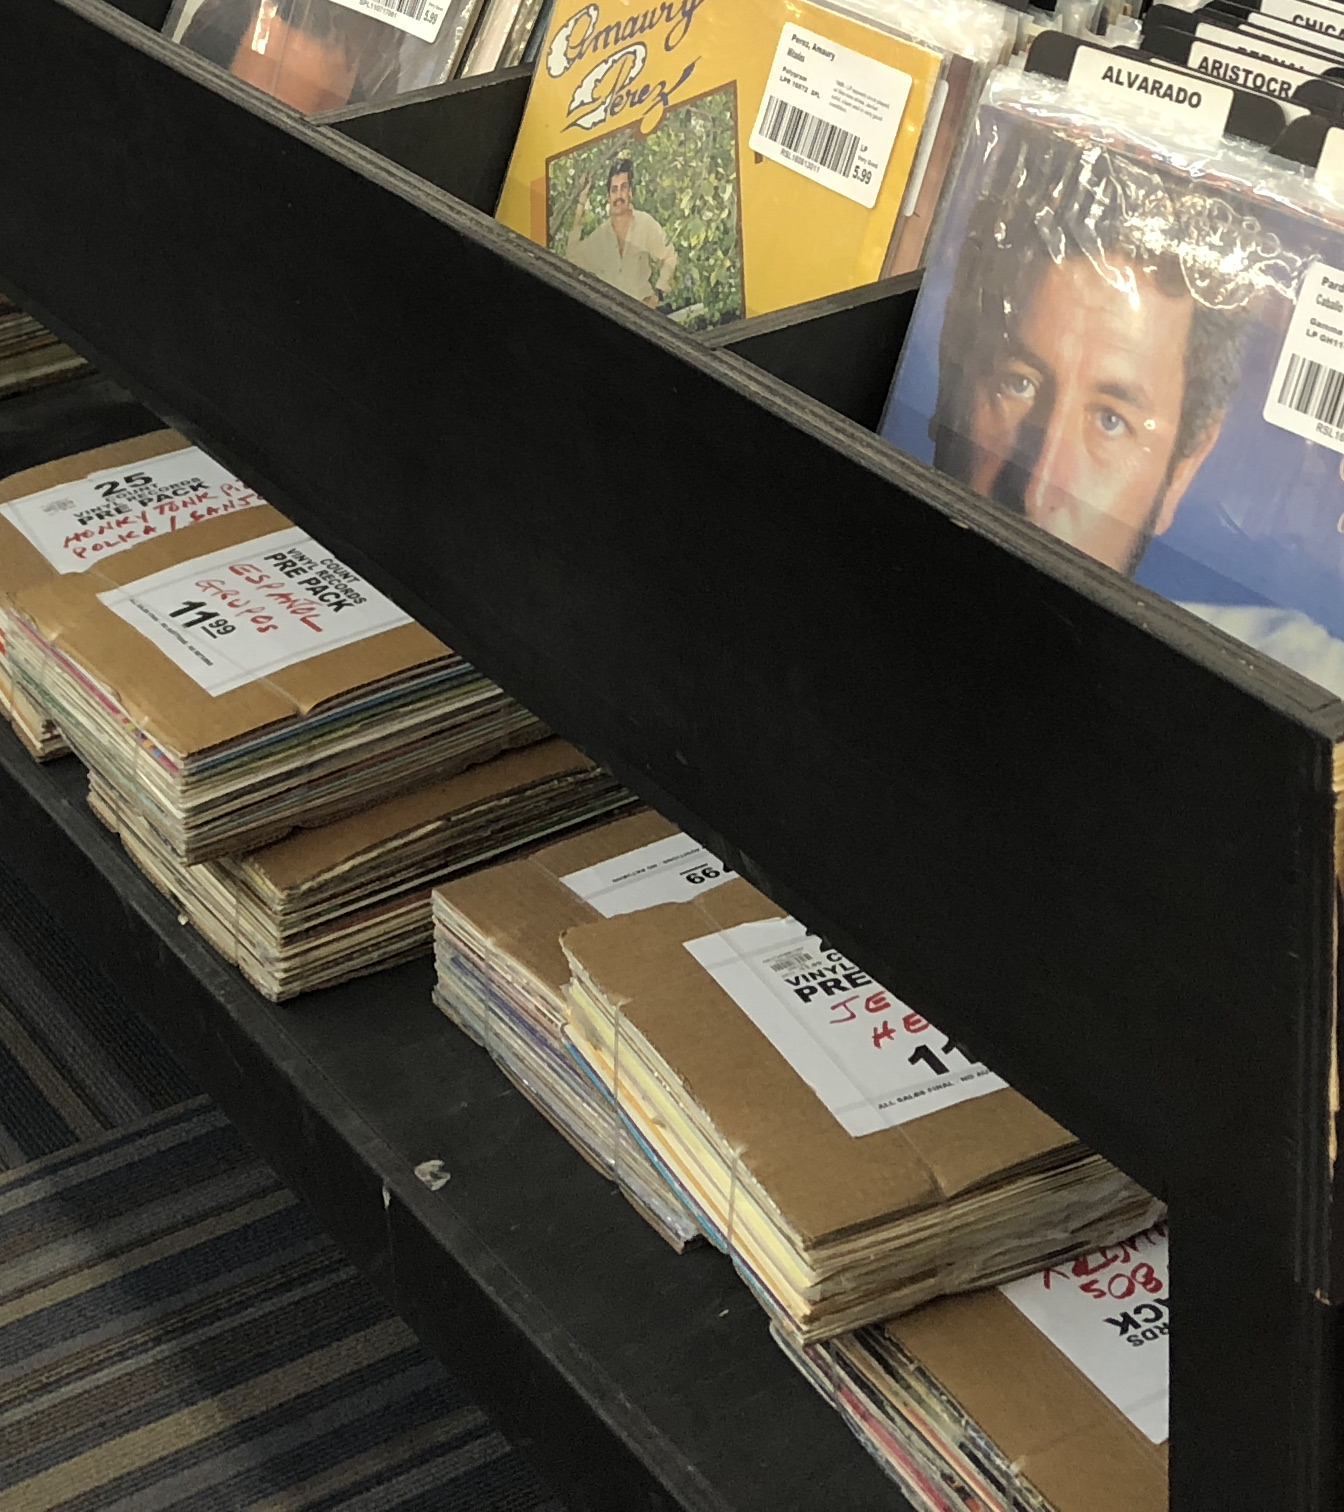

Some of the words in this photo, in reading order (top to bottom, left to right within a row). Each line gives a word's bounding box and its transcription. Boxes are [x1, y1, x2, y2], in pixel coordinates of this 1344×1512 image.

[561, 42, 703, 133] Perez
[1102, 65, 1202, 109] ALVARADO
[852, 165, 872, 185] 5.99
[94, 472, 153, 498] 25
[194, 578, 279, 634] GRUPOS
[264, 550, 306, 578] PRE
[296, 571, 356, 614] PACK
